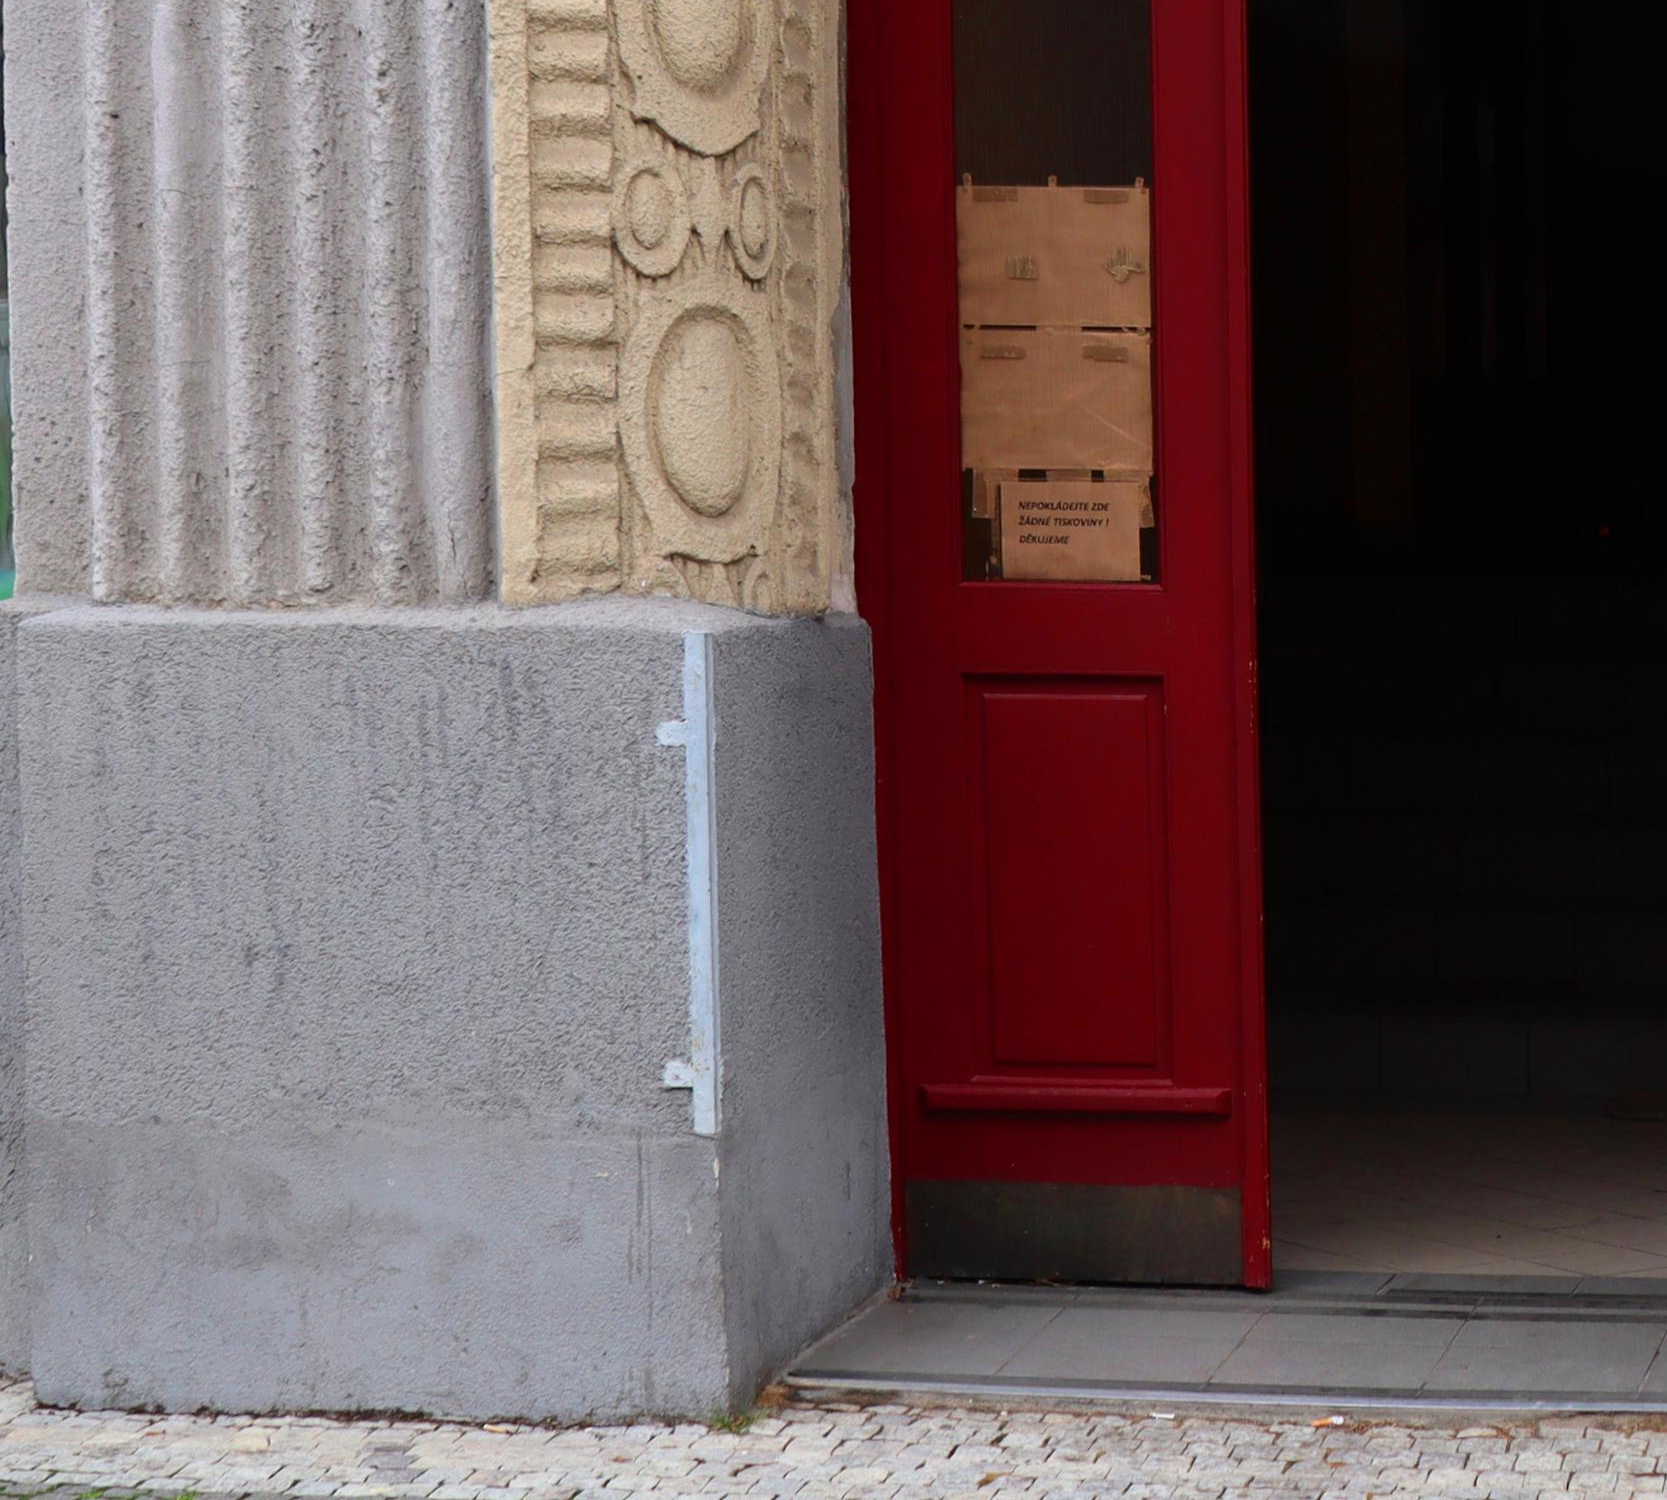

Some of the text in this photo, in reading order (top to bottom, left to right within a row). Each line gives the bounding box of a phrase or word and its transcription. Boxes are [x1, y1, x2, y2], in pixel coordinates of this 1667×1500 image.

[1018, 500, 1110, 512] NEPOKLÁDEJTE ZDE
[1018, 515, 1052, 527] ŽÁDNÉ
[1054, 518, 1104, 528] TISKOVINY
[1018, 533, 1070, 545] DĚKUJEME
